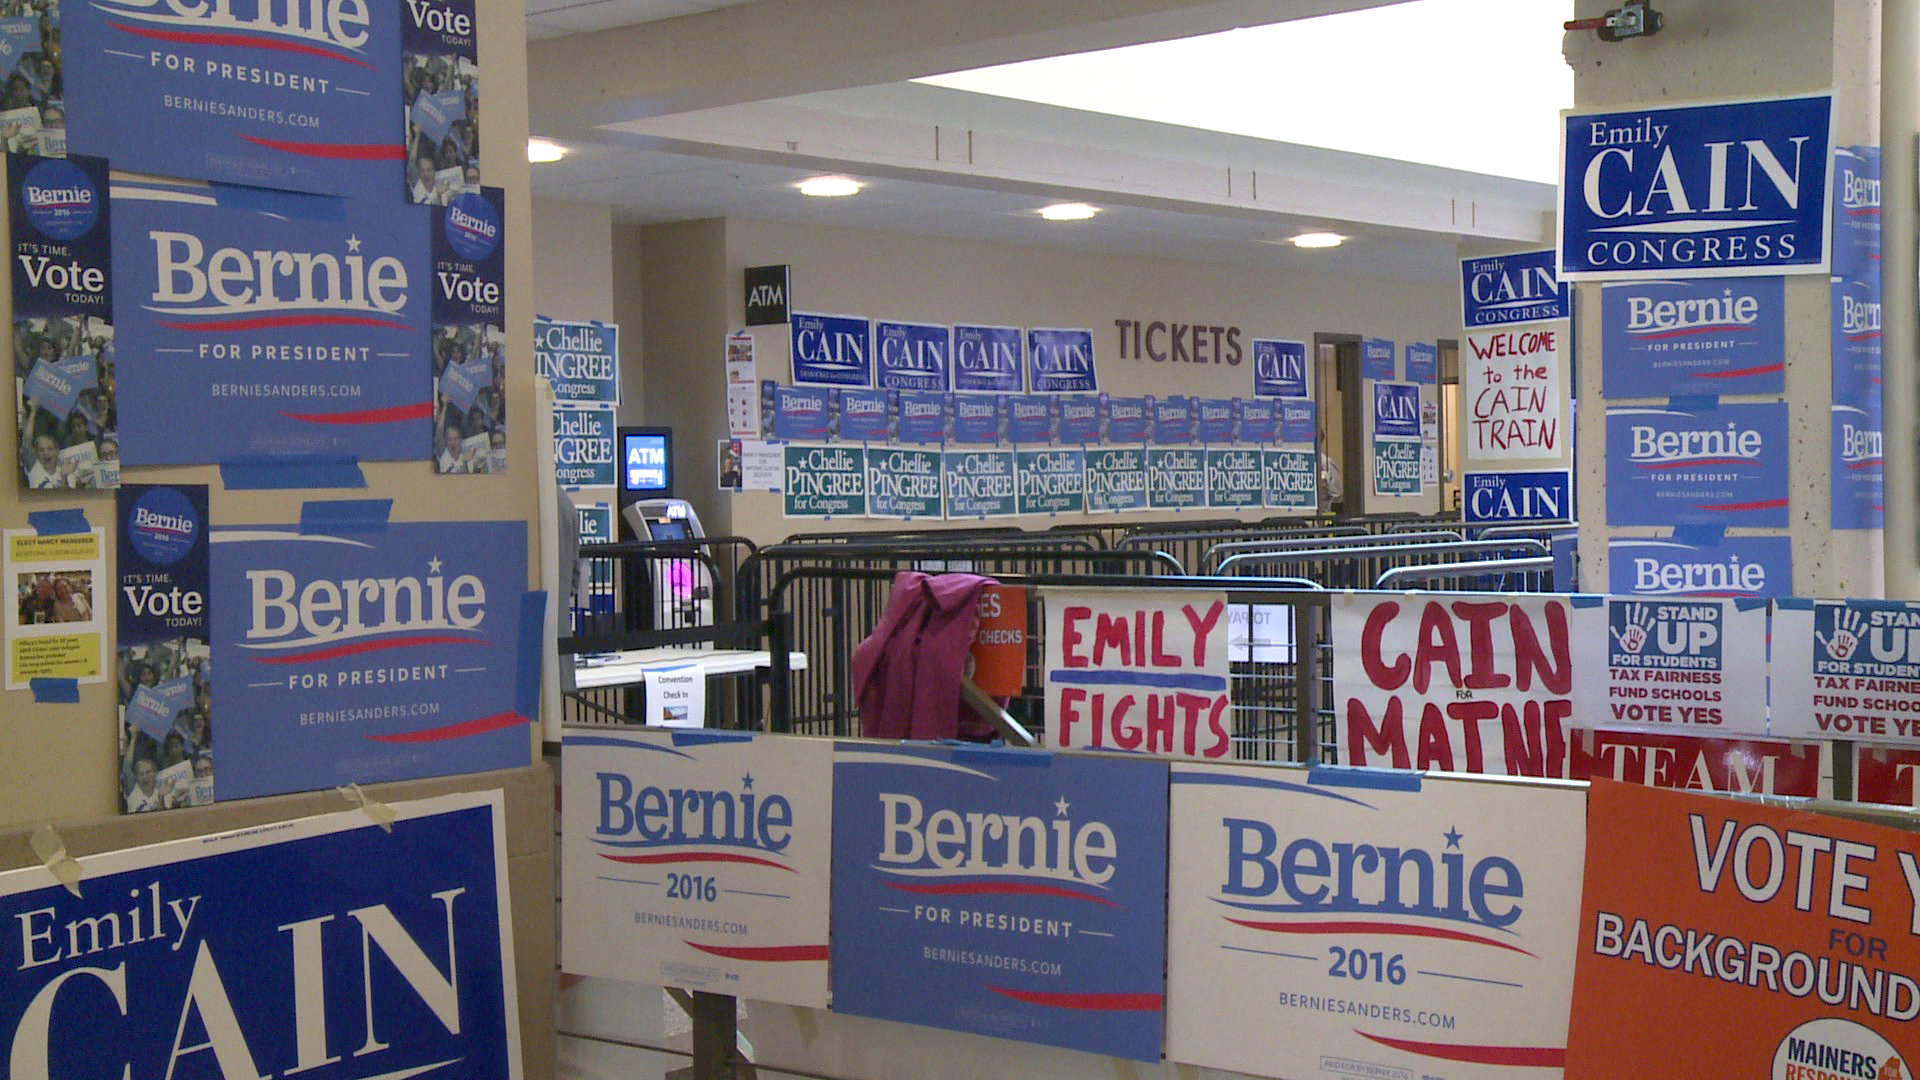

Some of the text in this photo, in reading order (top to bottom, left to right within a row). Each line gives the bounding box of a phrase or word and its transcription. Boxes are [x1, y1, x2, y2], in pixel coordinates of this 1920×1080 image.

[407, 0, 471, 35] Vote
[442, 34, 471, 47] TODAY!
[151, 51, 329, 94] FOR PRESIDENT
[164, 95, 320, 129] BERNIESANDERS.COM
[1590, 117, 1669, 149] Emily
[1583, 136, 1811, 219] CAIN
[28, 186, 92, 203] Bernie
[451, 206, 496, 237] Bernie
[18, 243, 70, 256] IT'S TIME.
[1587, 233, 1797, 266] CONGRESS
[18, 254, 104, 293] Vote
[150, 231, 409, 312] Bernie
[437, 261, 452, 271] IT'S
[1472, 261, 1505, 274] Emily
[437, 272, 499, 304] Vote
[748, 284, 784, 307] ATM
[1471, 266, 1559, 304] CAIN
[64, 293, 104, 305] TODAY!
[470, 304, 499, 314] TODAY!
[1627, 288, 1759, 330] Bernie
[799, 317, 824, 331] Emily
[1475, 304, 1560, 324] CONGRESS
[546, 327, 603, 352] Chellie
[883, 325, 906, 338] Emily
[960, 328, 982, 341] Emily
[1115, 319, 1243, 366] TICKETS
[199, 344, 371, 362] FOR PRESIDENT
[797, 329, 864, 365] CAIN
[881, 337, 944, 370] CAIN
[958, 340, 1016, 371] CAIN
[1468, 331, 1556, 360] WELCOME
[1647, 340, 1735, 352] FOR PRESIDENT
[536, 352, 614, 380] INGREE
[1034, 344, 1089, 372] CAIN
[1258, 353, 1301, 380] CAIN
[884, 376, 945, 389] CONGRESS
[1037, 379, 1091, 390] CONGRESS
[1483, 364, 1548, 384] to the
[211, 382, 362, 399] BERNIESANDERS.COM
[1474, 386, 1547, 419] CAIN
[782, 394, 822, 413] Bernie
[847, 397, 885, 413] Bernie
[905, 401, 941, 416] Bernie
[959, 402, 994, 417] Bernie
[1112, 404, 1142, 418] Bernie
[1158, 405, 1187, 419] Bernie
[1377, 395, 1416, 420] CAIN
[1472, 418, 1556, 450] TRAIN
[1631, 421, 1762, 459] Bernie
[628, 449, 664, 464] ATM
[808, 449, 854, 471] Chellie
[888, 452, 931, 473] Chellie
[1036, 453, 1075, 472] Chellie
[1103, 452, 1138, 471] Chellie
[1164, 451, 1198, 470] Chellie
[1223, 451, 1255, 470] Chellie
[1279, 453, 1309, 471] Chellie
[1387, 443, 1415, 460] Chellie
[965, 454, 1005, 474] Chellie
[1375, 456, 1418, 478] PINGREE
[786, 466, 864, 496] PINGREE
[869, 467, 939, 498] PINGREE
[947, 471, 1013, 498] PINGREE
[1019, 469, 1082, 496] PINGREE
[1088, 468, 1144, 493] PINGREE
[1150, 466, 1203, 491] PINGREE
[1209, 466, 1261, 490] PINGREE
[1265, 467, 1314, 491] PINGREE
[1473, 475, 1505, 489] Emily
[1676, 473, 1739, 481] PRESIDENT
[666, 505, 686, 519] ATM
[794, 496, 849, 514] for Congress
[876, 496, 925, 514] for Congress
[966, 499, 1000, 514] Congress
[1472, 486, 1561, 519] CAIN
[135, 507, 193, 534] Bernie
[123, 575, 142, 584] IT'S
[1634, 554, 1765, 590] Bernie
[123, 585, 203, 617] Vote
[246, 556, 486, 639] Bernie
[980, 593, 1001, 618] ES
[164, 617, 202, 628] TODAY!
[1657, 606, 1718, 621] STAND
[1871, 610, 1920, 627] STAN
[979, 630, 1023, 645] CHECKS
[1062, 600, 1224, 669] EMILY
[1657, 621, 1718, 655] UP
[1361, 600, 1572, 695] CAIN
[1612, 654, 1717, 669] FOR STUDENTS
[1818, 661, 1850, 674] FOR
[288, 664, 449, 691] FOR PRESIDENT
[658, 675, 693, 684] Convention
[1609, 668, 1722, 684] TAX FAIRNESS
[1814, 676, 1920, 694] TAX FAIRNE
[663, 690, 688, 699] Check In
[1456, 690, 1473, 699] FOR
[1609, 686, 1722, 701] FUND SCHOOLS
[1814, 695, 1920, 712] FUND SCHOO
[299, 703, 440, 726] BERNIESANDERS.COM
[1059, 687, 1229, 758] FIGHTS
[1611, 703, 1722, 725] VOTE YES
[1815, 713, 1920, 737] VOTE YE
[1601, 743, 1780, 797] TEAM
[595, 771, 793, 852] Bernie
[878, 793, 1117, 884] Bernie
[1221, 818, 1524, 928] Bernie
[1688, 812, 1877, 924] VOTE
[667, 873, 717, 903] 2016
[14, 880, 202, 974] Emily
[634, 911, 748, 936] BERNIESANDERS.COM
[914, 905, 1073, 938] FOR PRESIDENT
[1828, 927, 1888, 962] FOR
[923, 946, 1062, 977] BERNIESANDERS.COM
[1327, 946, 1407, 985] 2016
[1594, 910, 1920, 1022] BACKGROUND
[9, 887, 466, 1080] CAIN
[1279, 992, 1456, 1030] BERNIESANDERS.COM
[1788, 1037, 1877, 1080] MAINERS
